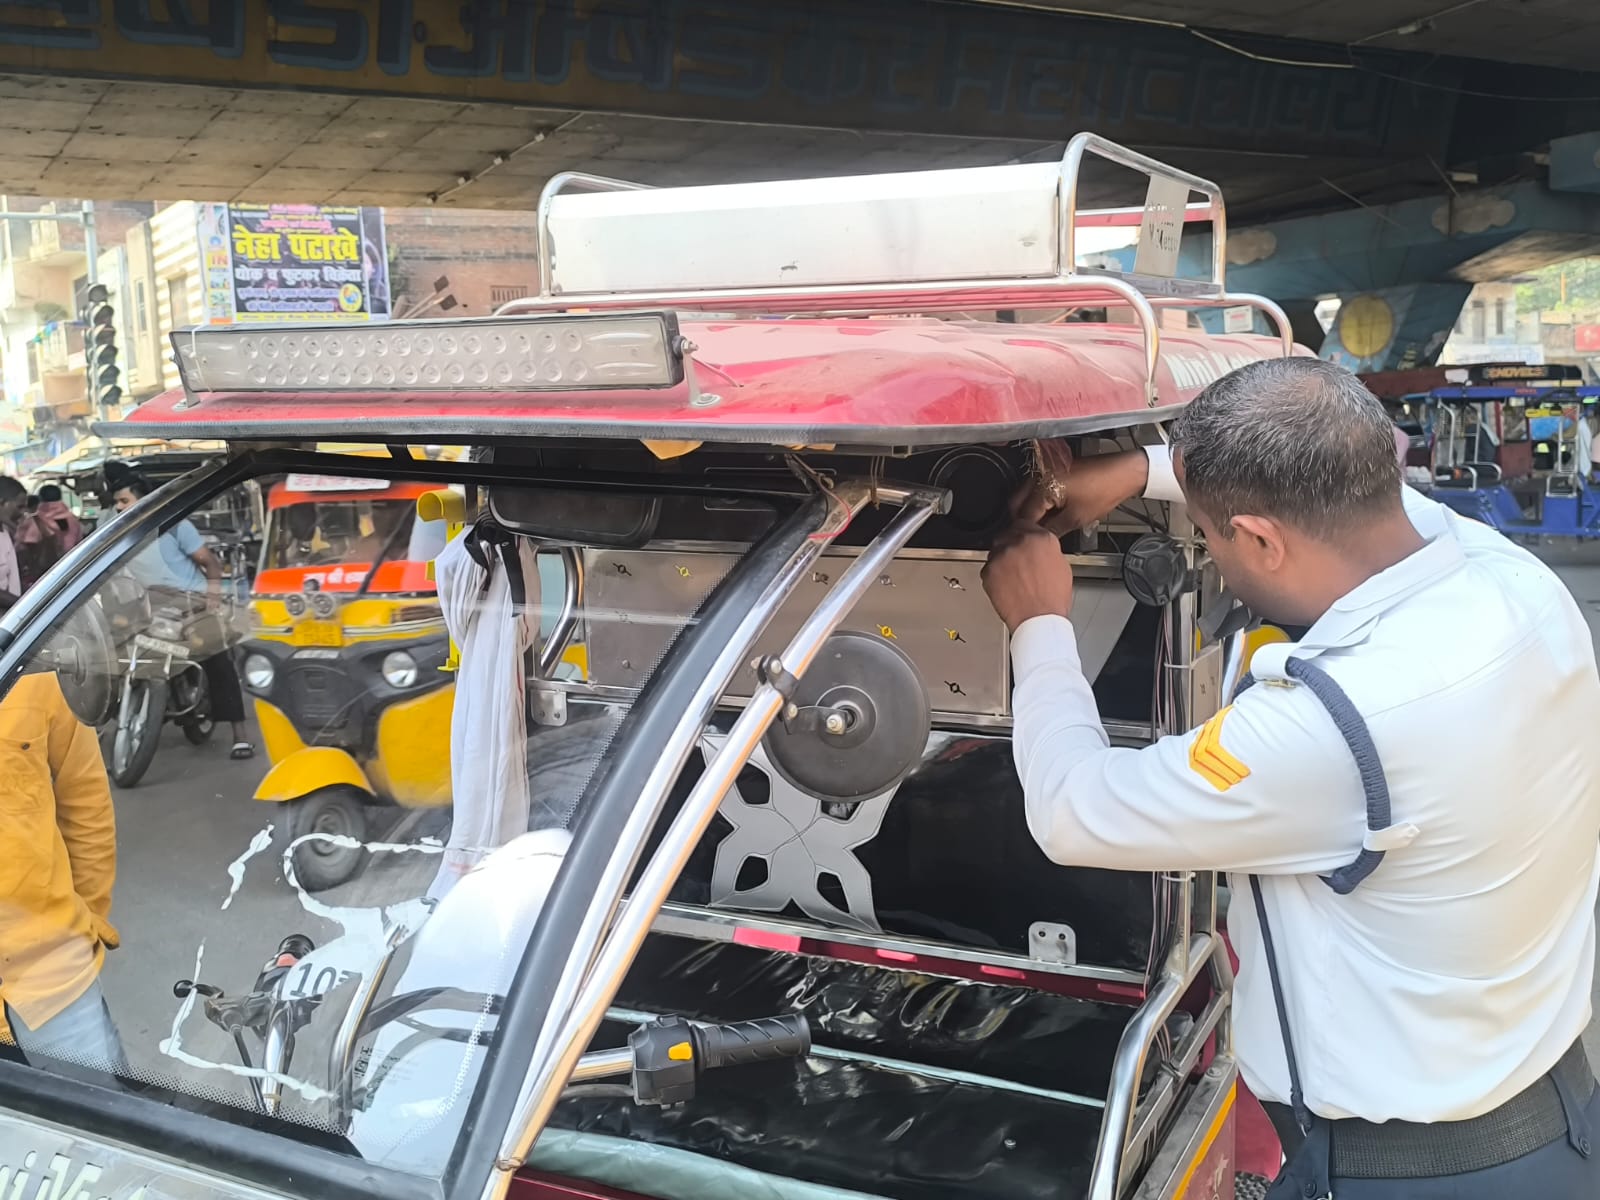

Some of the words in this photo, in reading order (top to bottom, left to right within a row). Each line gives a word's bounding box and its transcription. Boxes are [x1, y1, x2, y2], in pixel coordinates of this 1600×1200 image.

[232, 224, 281, 262] नेहा
[288, 227, 360, 262] पटाखे
[281, 268, 321, 286] फुटकर
